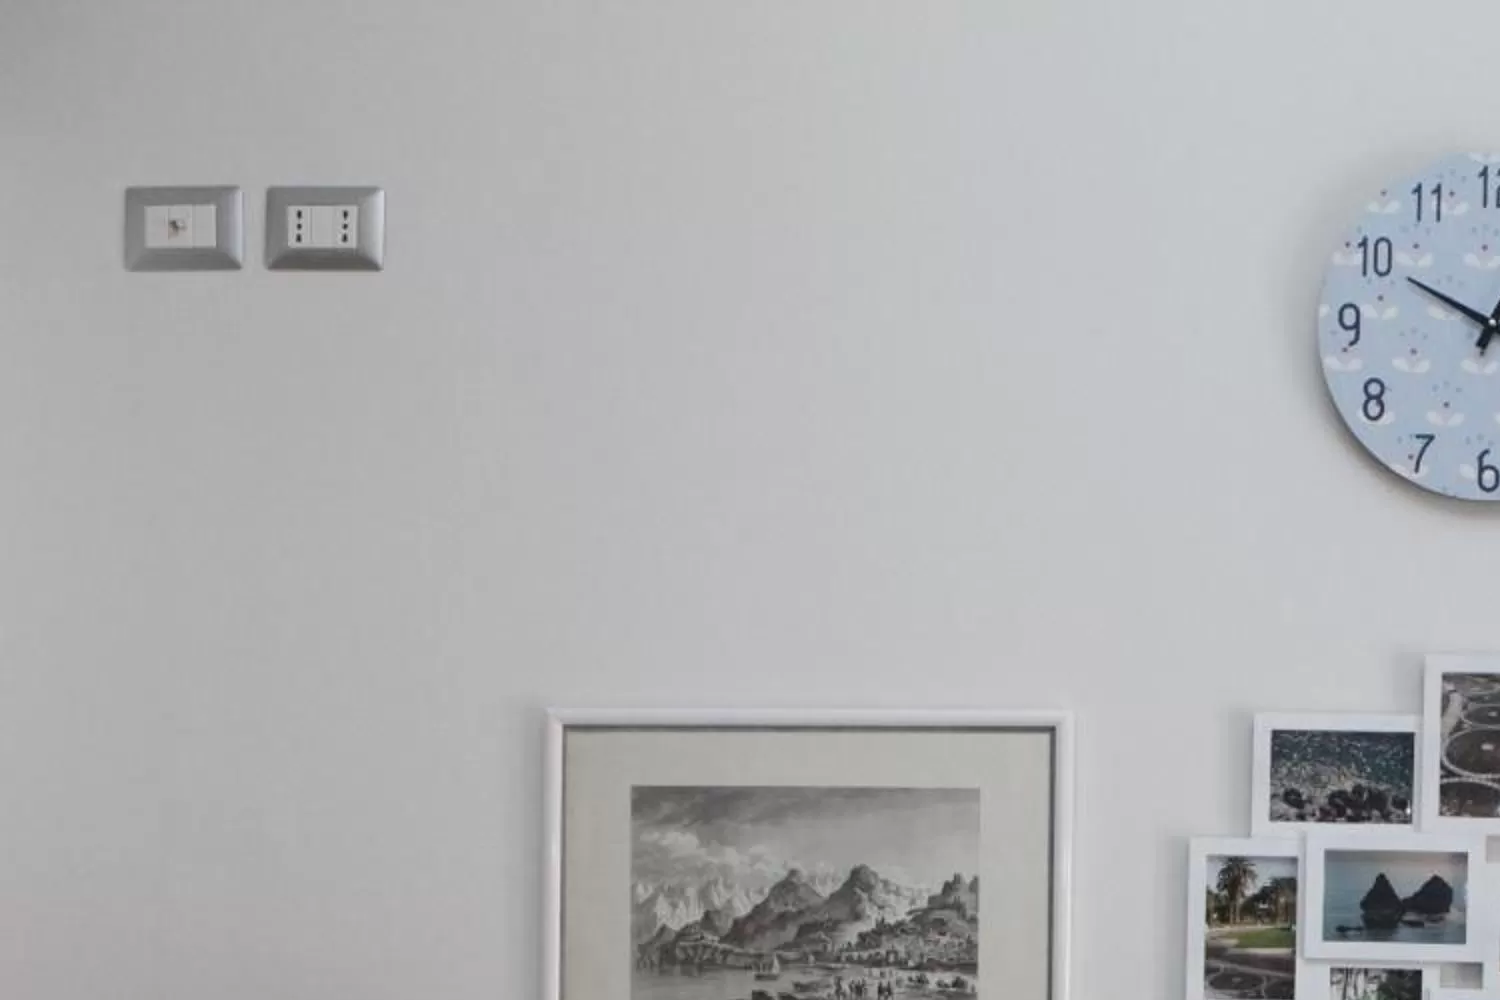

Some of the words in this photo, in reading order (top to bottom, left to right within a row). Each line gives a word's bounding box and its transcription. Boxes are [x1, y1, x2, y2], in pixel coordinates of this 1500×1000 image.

[1411, 182, 1442, 222] 11
[1357, 235, 1393, 277] 10
[1338, 303, 1360, 347] 9
[1363, 378, 1385, 421] 8
[1414, 434, 1435, 473] 7
[1477, 448, 1500, 493] 6
